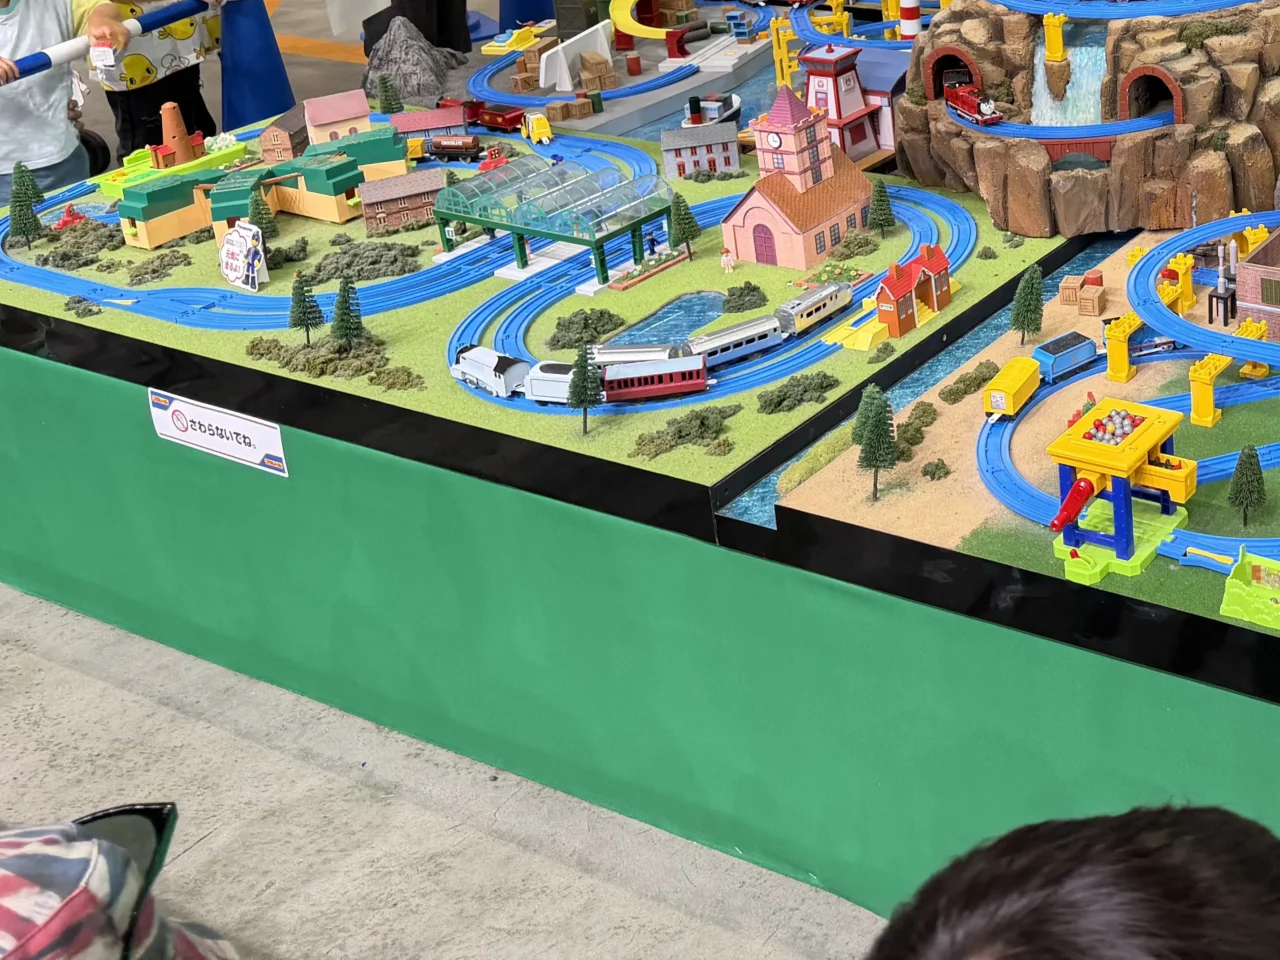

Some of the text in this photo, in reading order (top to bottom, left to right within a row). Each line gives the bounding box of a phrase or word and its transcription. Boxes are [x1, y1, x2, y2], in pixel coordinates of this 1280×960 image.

[189, 419, 257, 450] さわらないでね。
